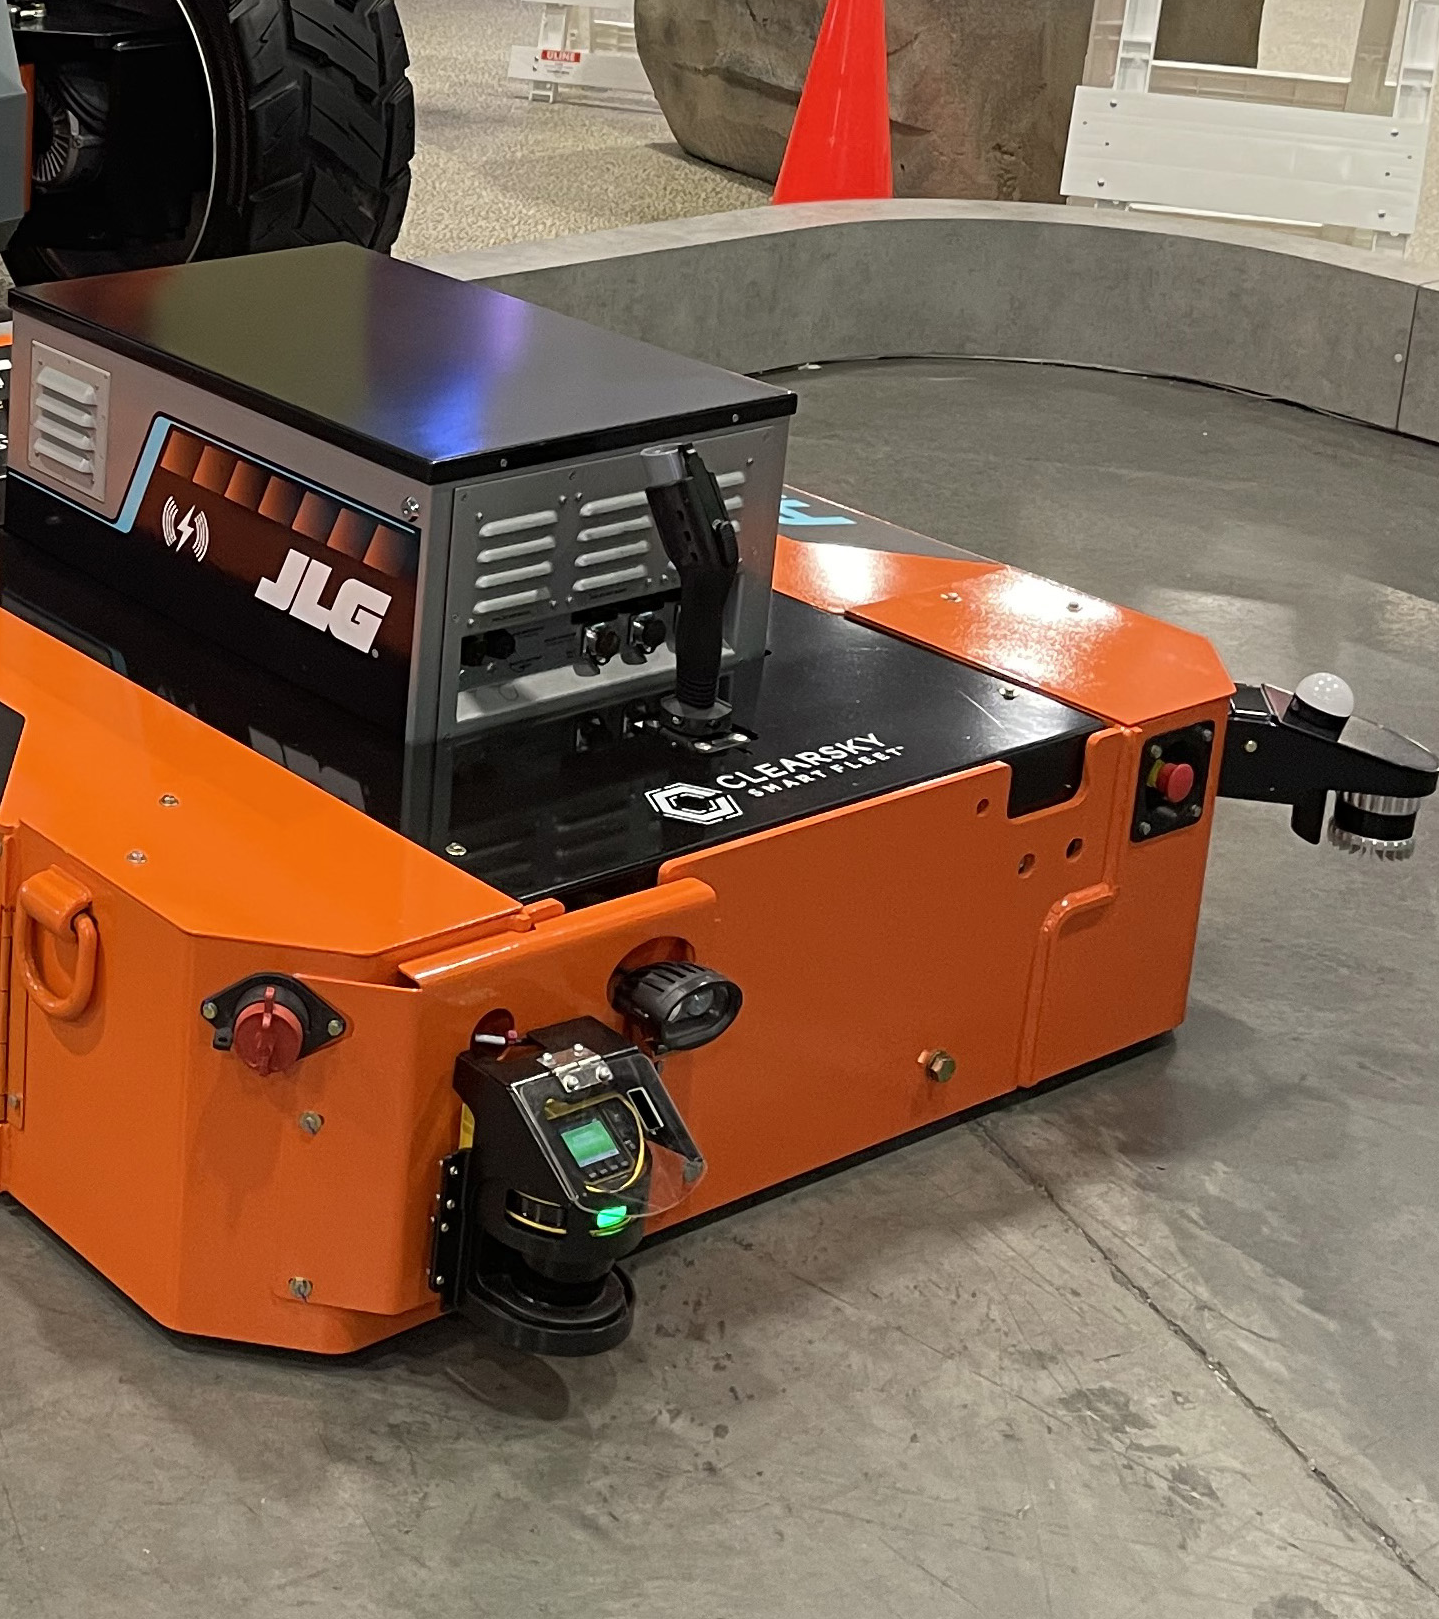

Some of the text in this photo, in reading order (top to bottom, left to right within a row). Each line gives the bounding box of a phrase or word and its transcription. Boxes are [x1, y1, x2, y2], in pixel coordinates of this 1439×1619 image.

[546, 49, 577, 62] ULINE
[254, 548, 393, 654] JLG
[716, 732, 885, 789] CLEARSKY
[747, 747, 903, 798] SMART FLEET
